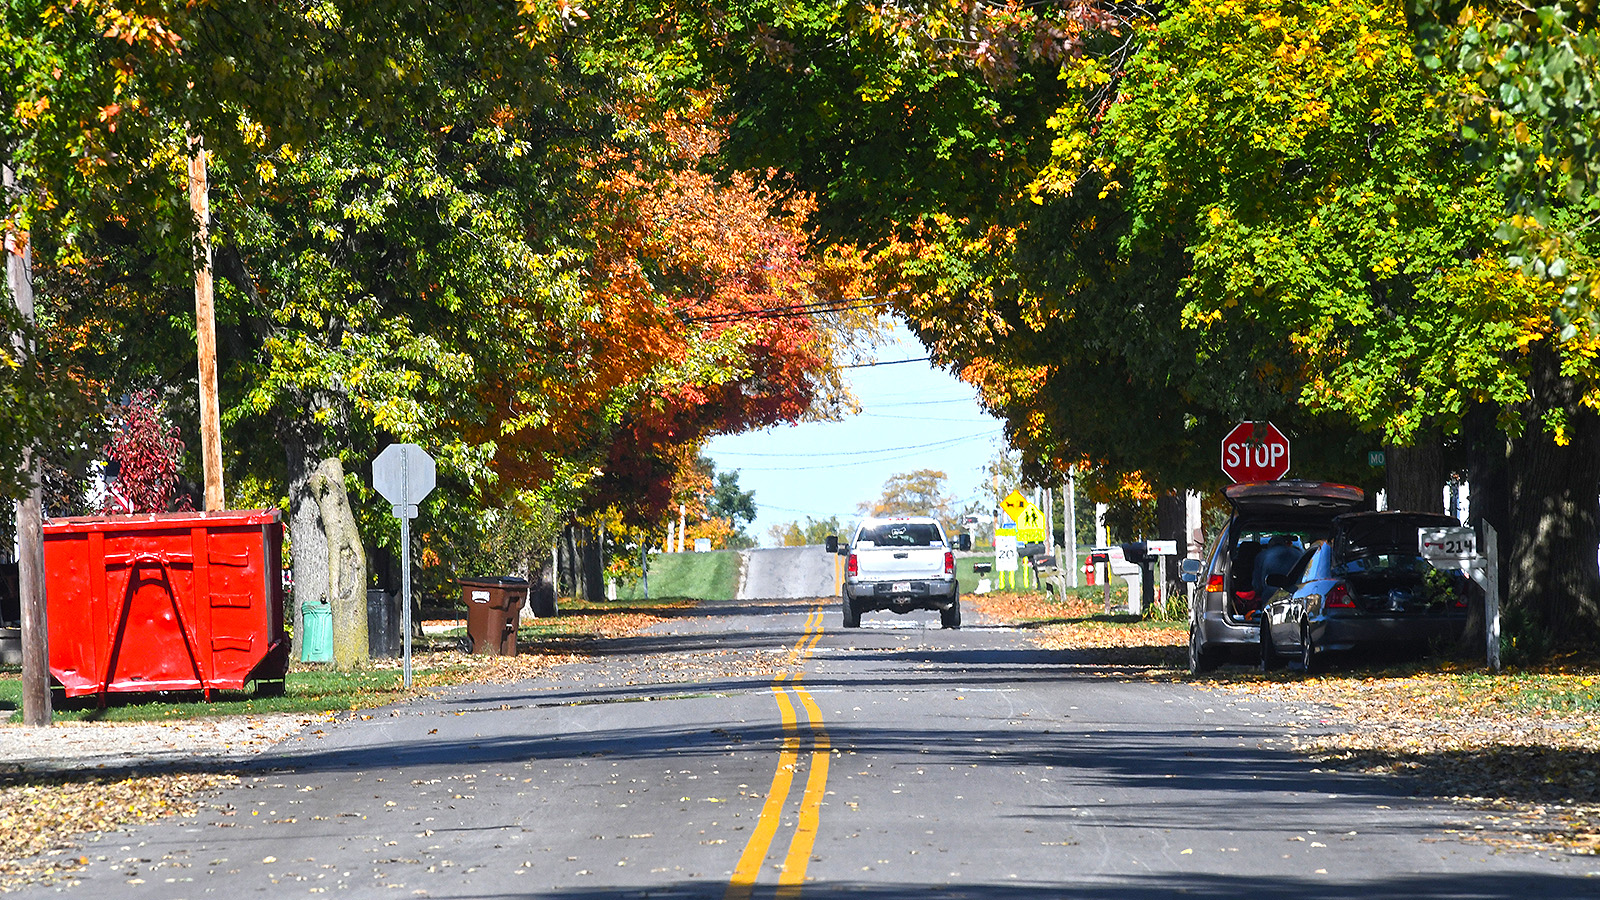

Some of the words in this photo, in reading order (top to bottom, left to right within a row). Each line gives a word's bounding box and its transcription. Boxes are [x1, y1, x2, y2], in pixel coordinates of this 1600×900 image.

[1226, 443, 1285, 468] STOP
[1445, 540, 1473, 553] 214
[998, 549, 1015, 560] 20
